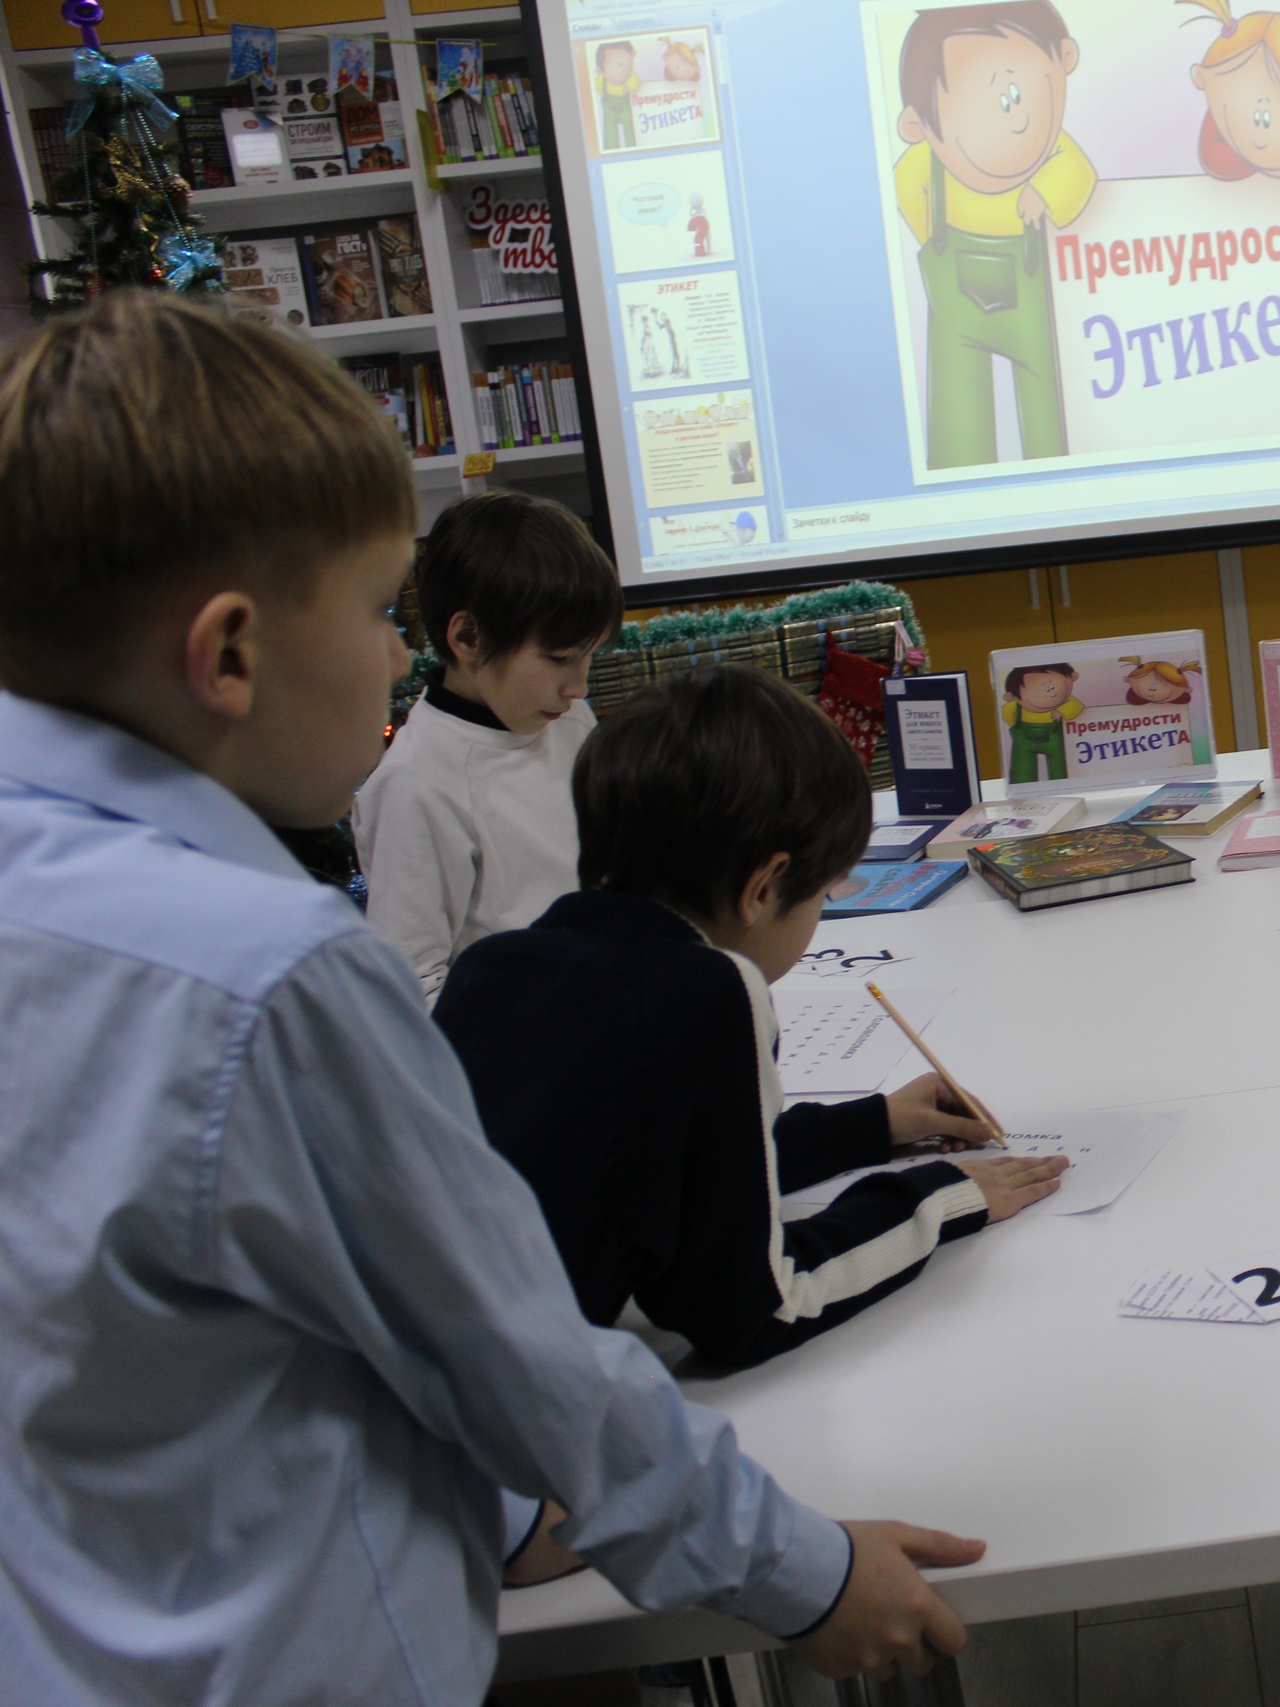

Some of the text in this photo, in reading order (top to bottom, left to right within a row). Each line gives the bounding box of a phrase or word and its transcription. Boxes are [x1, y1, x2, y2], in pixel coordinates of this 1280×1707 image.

[631, 89, 697, 109] Премудрости
[288, 121, 333, 138] СТРОИМ
[266, 272, 298, 285] ХЛЕБ
[657, 280, 700, 294] ЭТИКЕТ
[792, 515, 830, 529] Заметки
[839, 511, 871, 525] слайду
[904, 708, 940, 720] Этикет
[1065, 713, 1182, 737] Премудрости
[1002, 1132, 1062, 1141] ломка
